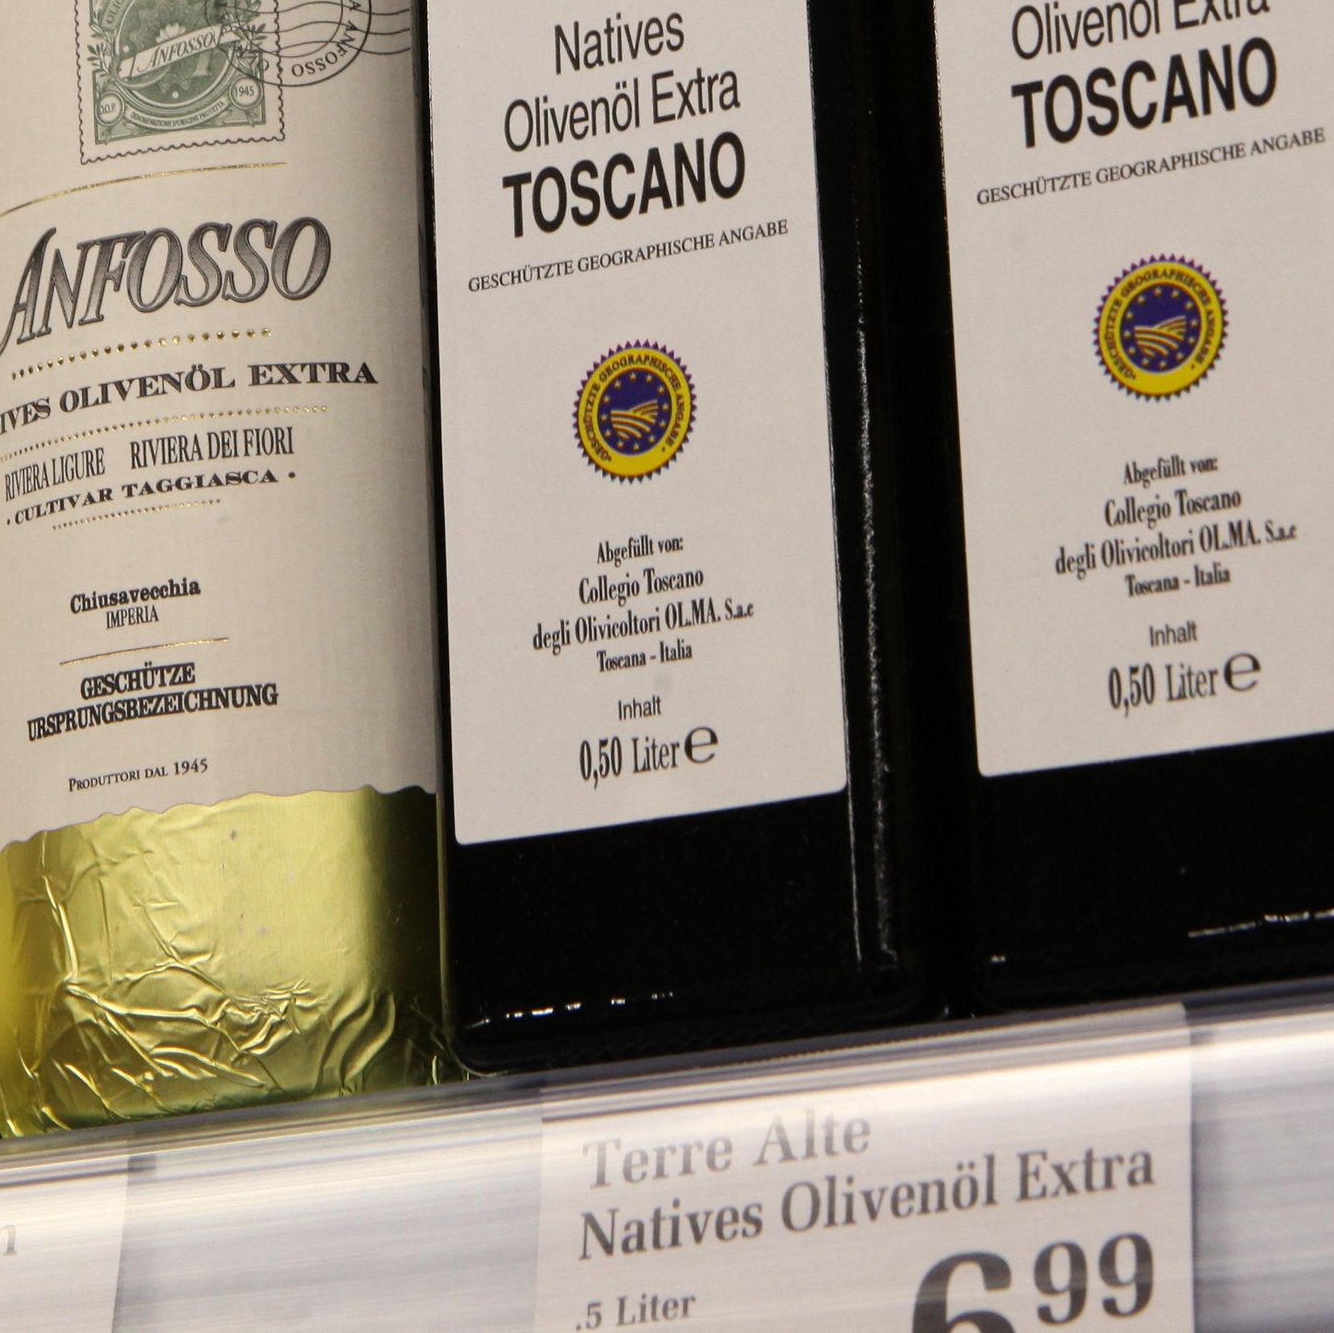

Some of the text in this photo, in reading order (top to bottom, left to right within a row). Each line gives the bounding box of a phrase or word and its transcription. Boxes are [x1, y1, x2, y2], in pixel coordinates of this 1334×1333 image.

[554, 11, 685, 74] Natives
[504, 68, 741, 153] Olivenöl Extra
[1011, 36, 1277, 149] TOSCANO
[502, 131, 746, 238] TOSCANO
[976, 127, 1326, 206] GESCHÜTZTE GEOGRAPHISCHE ANGABE
[467, 219, 788, 292] GESCHÜTZTE GEOGRAPHISCHE ANGABE
[59, 364, 236, 413] OLIVENÖL
[248, 361, 378, 383] EXTRA
[4, 427, 294, 502] RIVIERA LIGURE RIVIERA DEI FIORI
[1123, 453, 1186, 488] Abgefüllt
[13, 470, 278, 525] CULTIVAR TAGGIASCA
[1104, 486, 1241, 529] Collegio Toscano
[596, 535, 653, 567] Abgefüllt
[1055, 529, 1195, 579] degli Olivicoltori
[70, 577, 201, 614] Chiusavecchia
[578, 567, 703, 607] Collegio Toscano
[1125, 564, 1230, 598] Toscana Italia
[106, 605, 159, 629] IMPERIA
[532, 606, 661, 656] degli Olivicoltori
[1149, 620, 1198, 647] Inhalt
[81, 662, 195, 700] GESCHÜTZE
[596, 640, 693, 673] Toscana Italia
[28, 683, 279, 742] URSPRUNGSBEZEICHNUNG
[618, 695, 662, 721] Inhalt
[1108, 663, 1218, 717] 0,50 Liter
[174, 758, 208, 776] 1945
[579, 735, 680, 790] 0,50 Liter
[582, 1109, 871, 1189] Terre Alte
[579, 1145, 1155, 1262] Natives Olivenöl Extra
[1033, 1232, 1154, 1326] 99
[575, 1291, 696, 1332] .5 Liter
